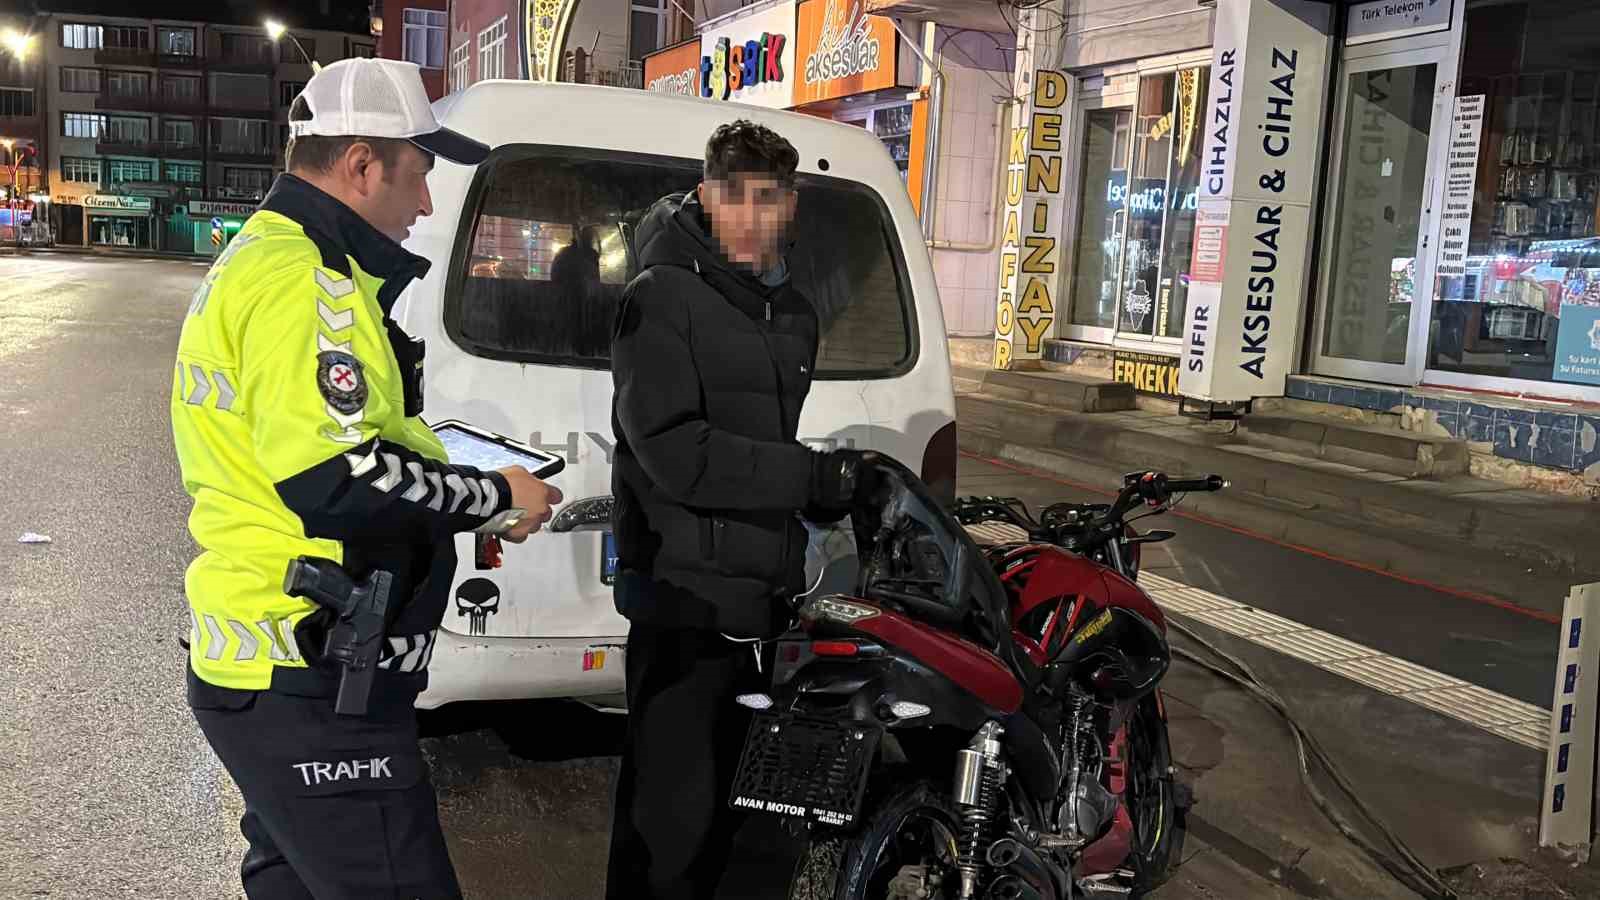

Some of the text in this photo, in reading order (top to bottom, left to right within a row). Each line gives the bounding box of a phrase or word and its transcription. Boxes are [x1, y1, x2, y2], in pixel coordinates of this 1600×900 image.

[1384, 2, 1424, 17] Telekom
[1206, 48, 1236, 195] CİHAZLAR
[1240, 48, 1298, 380] AKSESUAR & CİHAZ
[1188, 305, 1210, 372] SIFIR
[1115, 360, 1167, 394] ERKEK
[734, 796, 806, 817] AVAN MOTOR
